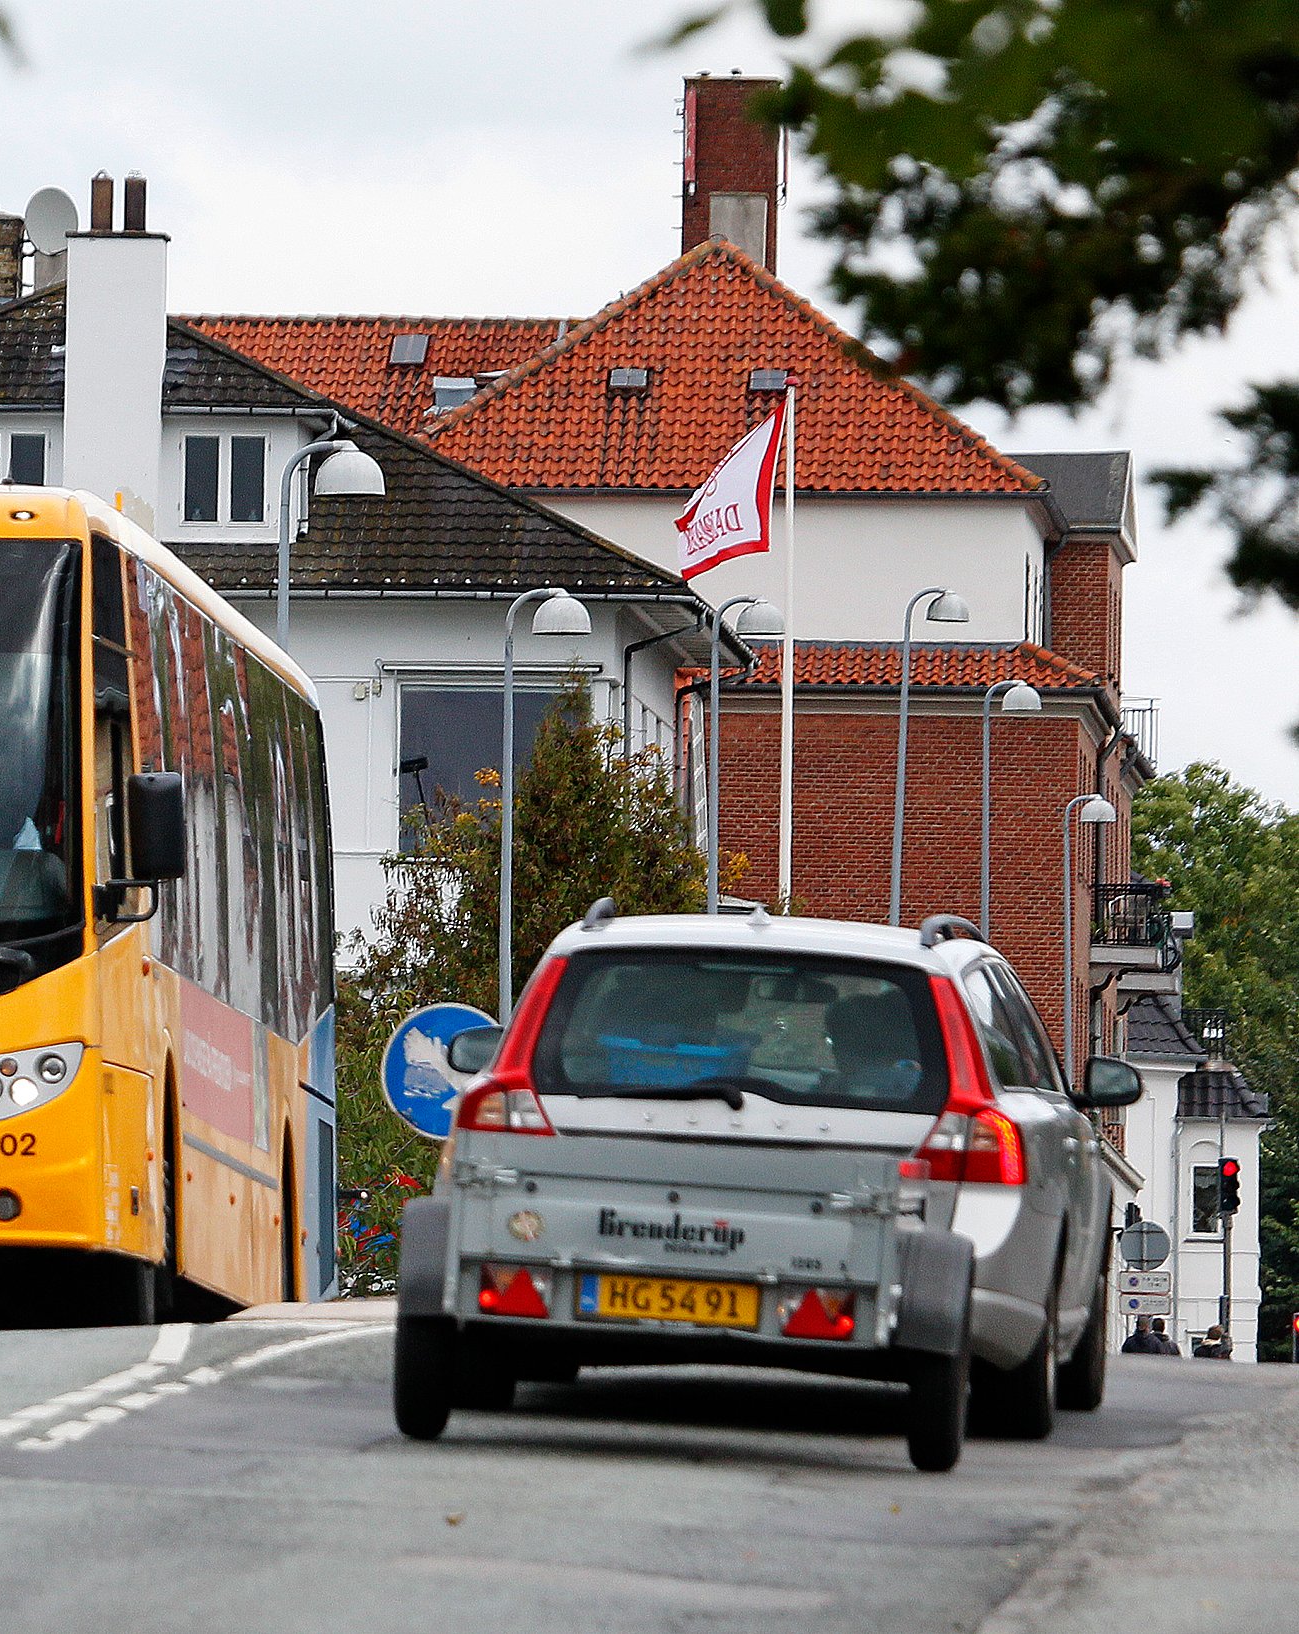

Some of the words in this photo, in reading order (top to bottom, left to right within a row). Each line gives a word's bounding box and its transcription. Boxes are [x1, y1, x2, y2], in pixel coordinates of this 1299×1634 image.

[609, 1279, 653, 1312] HG
[660, 1283, 696, 1315] 54
[705, 1287, 739, 1319] 91
